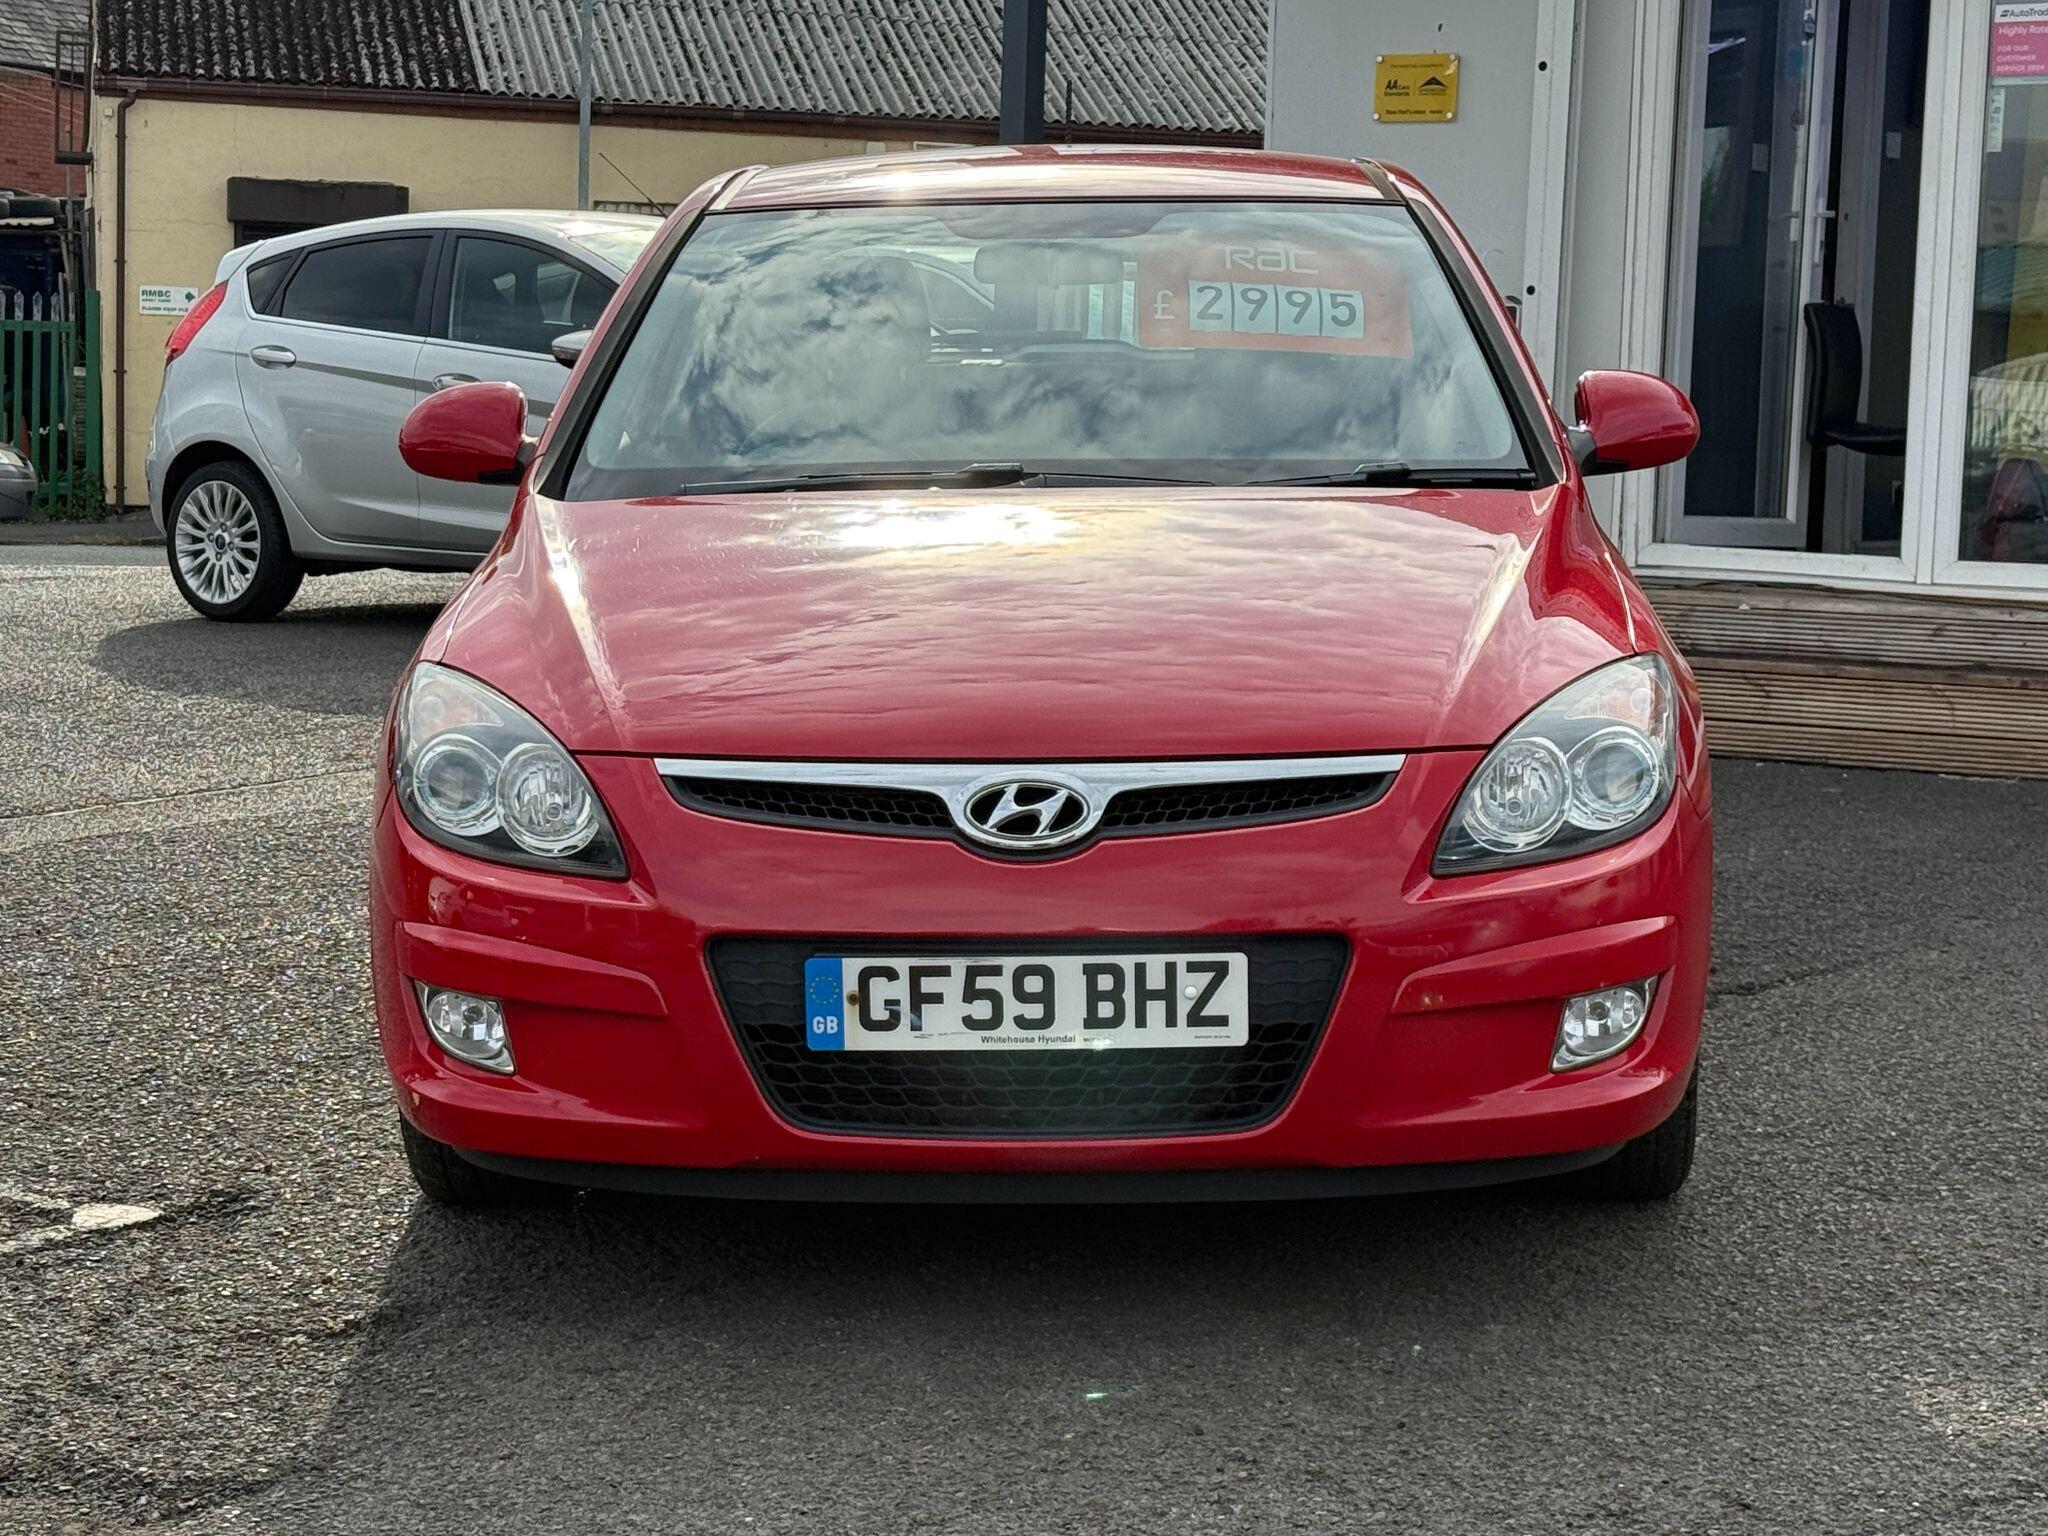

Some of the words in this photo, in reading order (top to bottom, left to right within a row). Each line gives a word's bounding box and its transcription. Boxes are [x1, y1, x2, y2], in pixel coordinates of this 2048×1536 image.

[1998, 24, 2027, 37] Highly
[1997, 45, 2011, 53] FOR
[2013, 44, 2029, 52] OUR
[1996, 54, 2036, 63] CUSTOMER
[1153, 289, 1175, 320] £
[1196, 284, 1357, 328] 2995
[857, 963, 1055, 1033] GF59
[1082, 960, 1230, 1030] BHZ
[812, 1015, 839, 1034] GB
[981, 1035, 1036, 1044] Whitehouse
[1038, 1034, 1076, 1045] Hyundai
